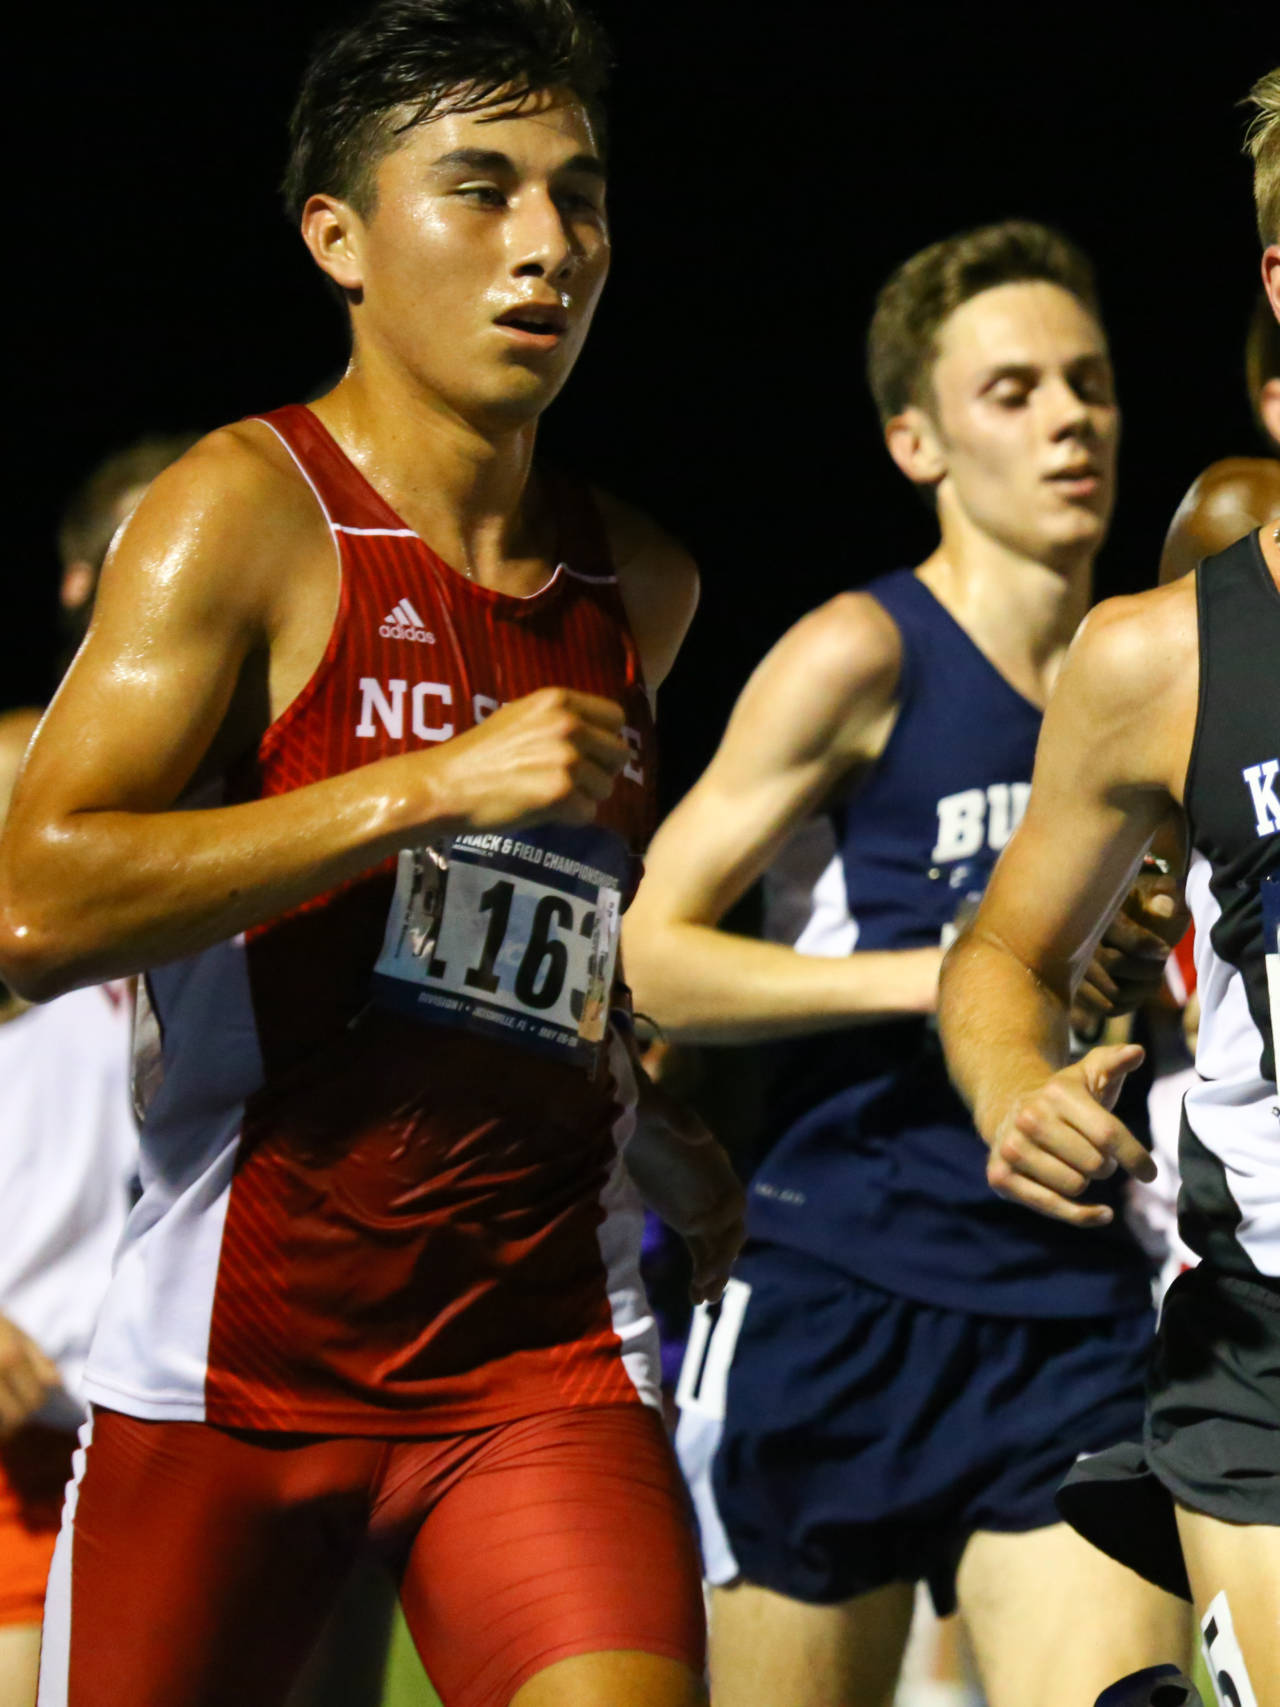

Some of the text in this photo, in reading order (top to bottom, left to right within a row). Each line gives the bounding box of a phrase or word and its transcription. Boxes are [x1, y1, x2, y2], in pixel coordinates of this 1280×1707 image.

[378, 624, 437, 646] adidas
[355, 677, 455, 742] NC
[512, 841, 543, 864] FIELD
